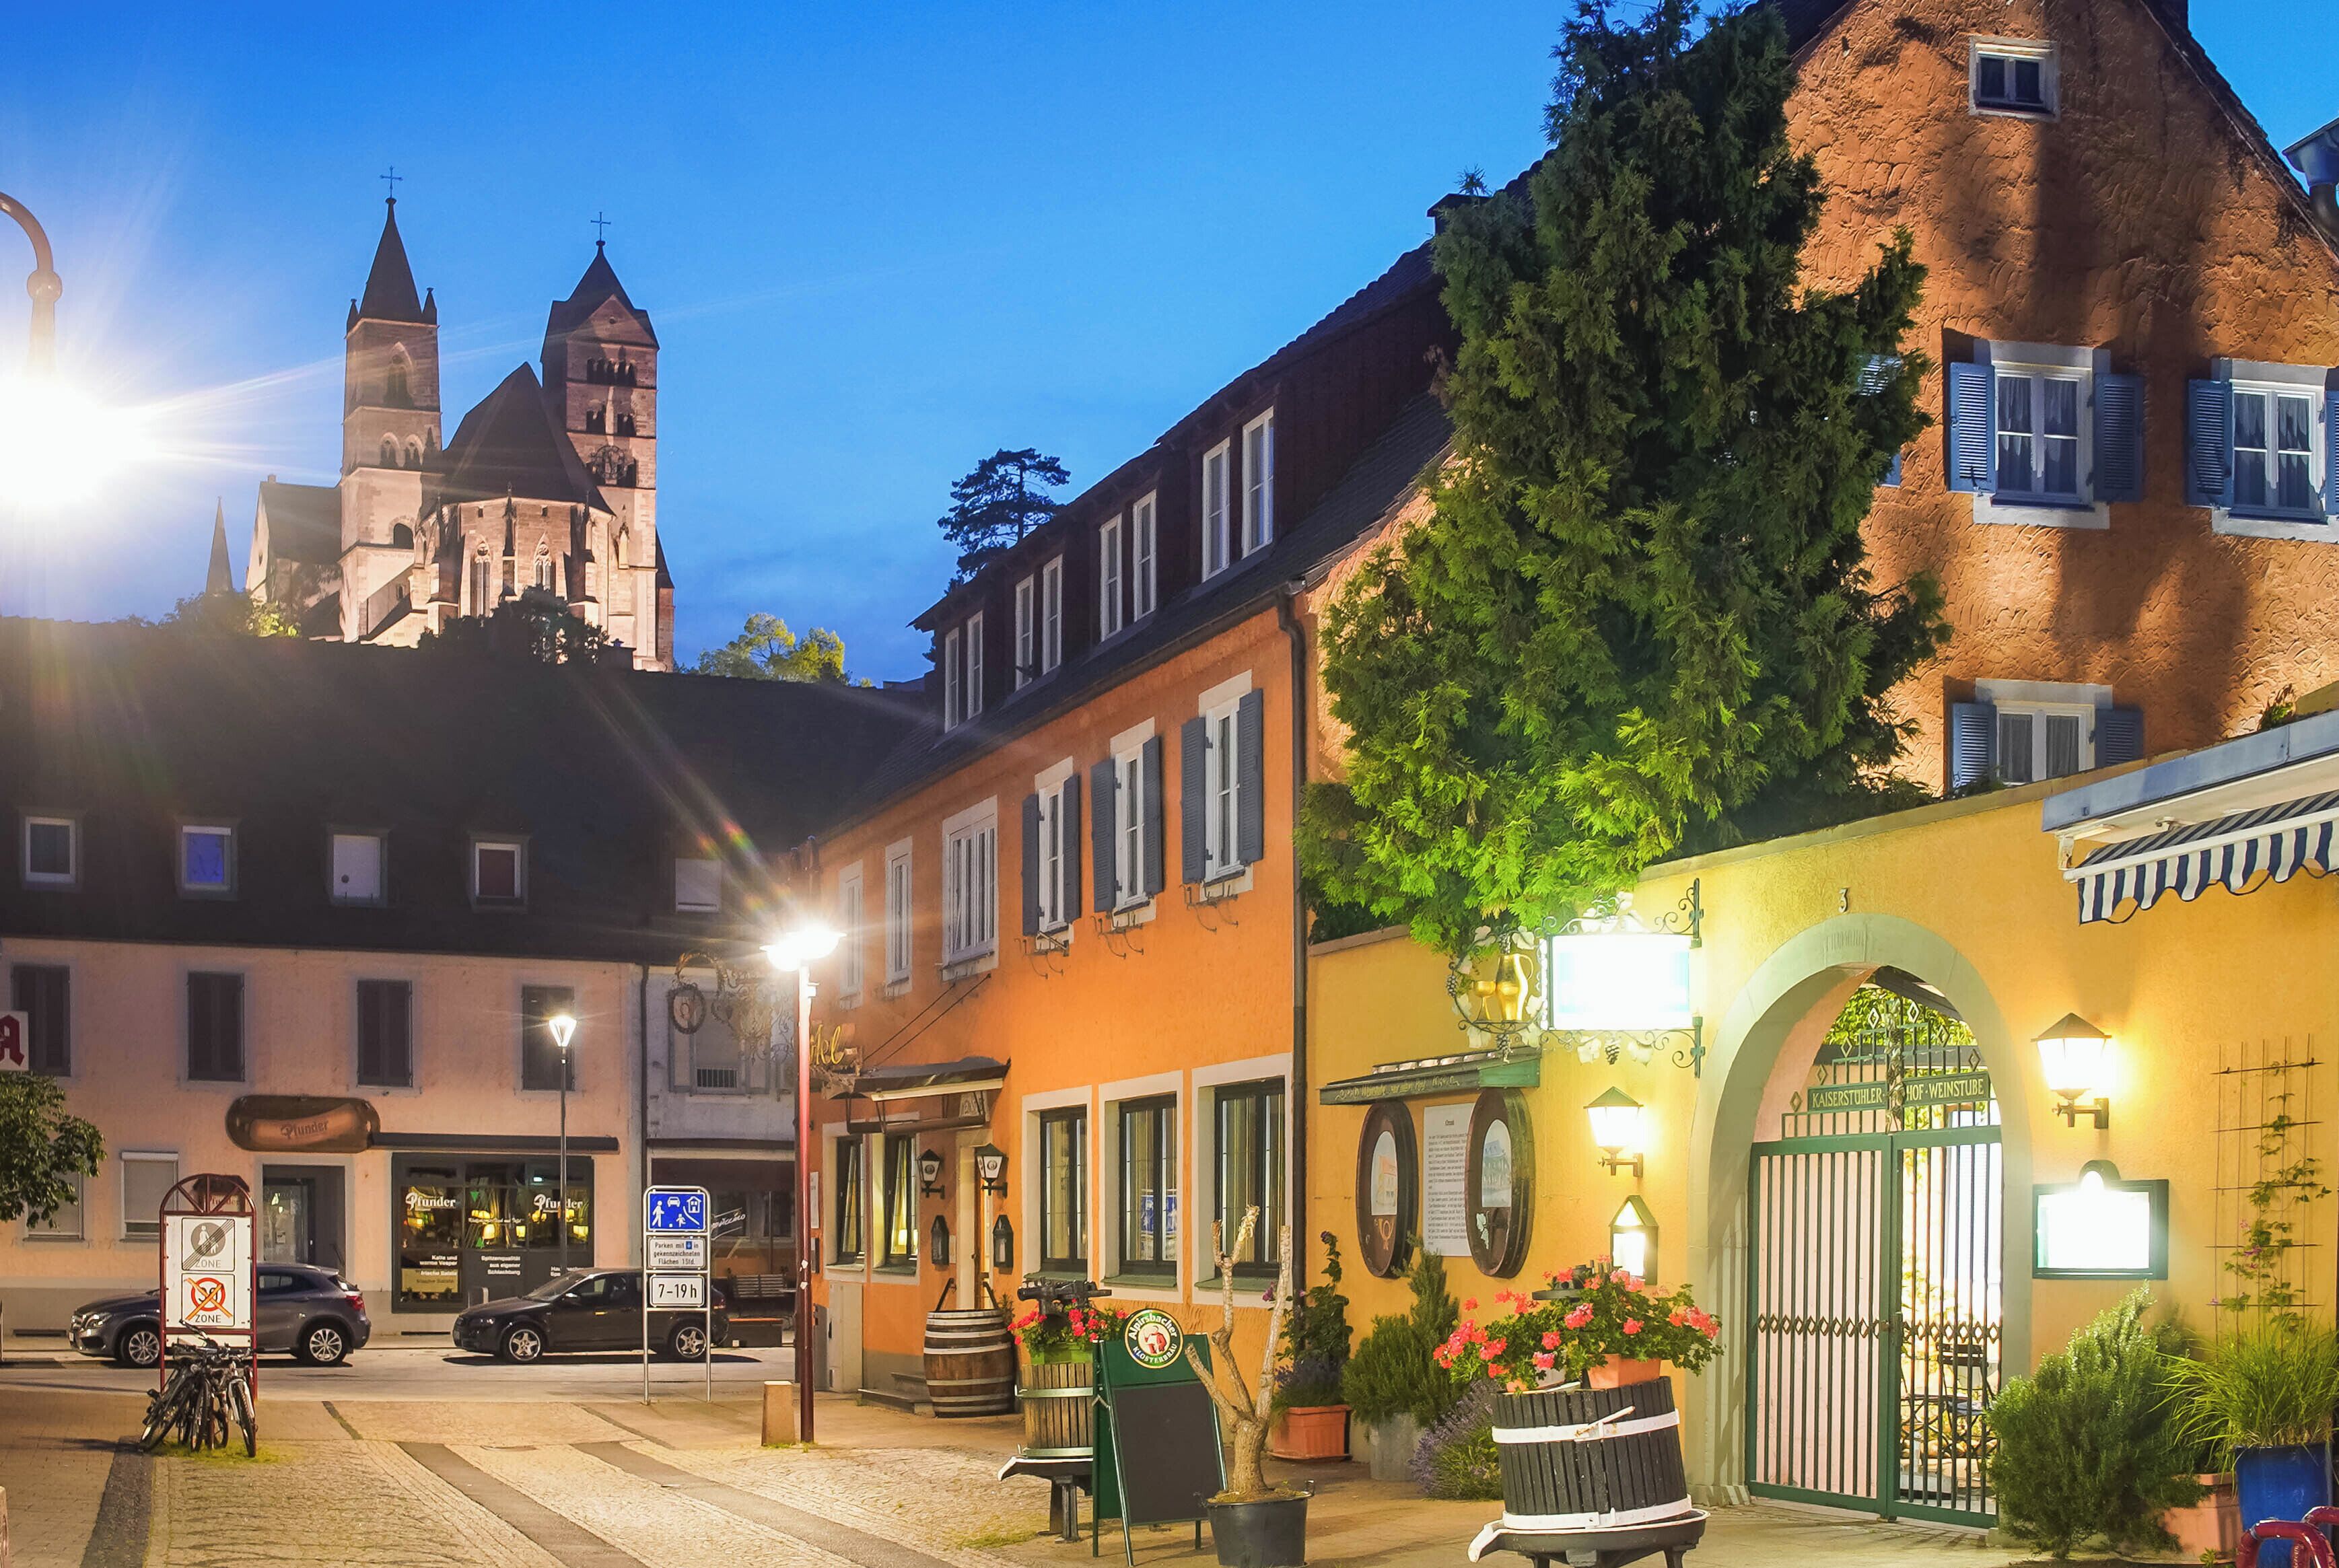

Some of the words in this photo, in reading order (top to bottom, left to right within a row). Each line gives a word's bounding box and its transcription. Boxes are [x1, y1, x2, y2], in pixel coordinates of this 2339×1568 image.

[1838, 887, 1848, 913] 3
[1812, 1087, 1883, 1108] KAISERSTÜHLER
[1906, 1083, 1924, 1101] HOF
[1928, 1078, 1985, 1099] WEINSTUBE
[280, 1120, 329, 1140] Pfunder
[405, 1192, 456, 1211] Pfunder
[195, 1259, 221, 1269] ZONE
[691, 1283, 697, 1299] h
[195, 1314, 221, 1323] ZONE
[1128, 1313, 1178, 1341] Alpirsbacher
